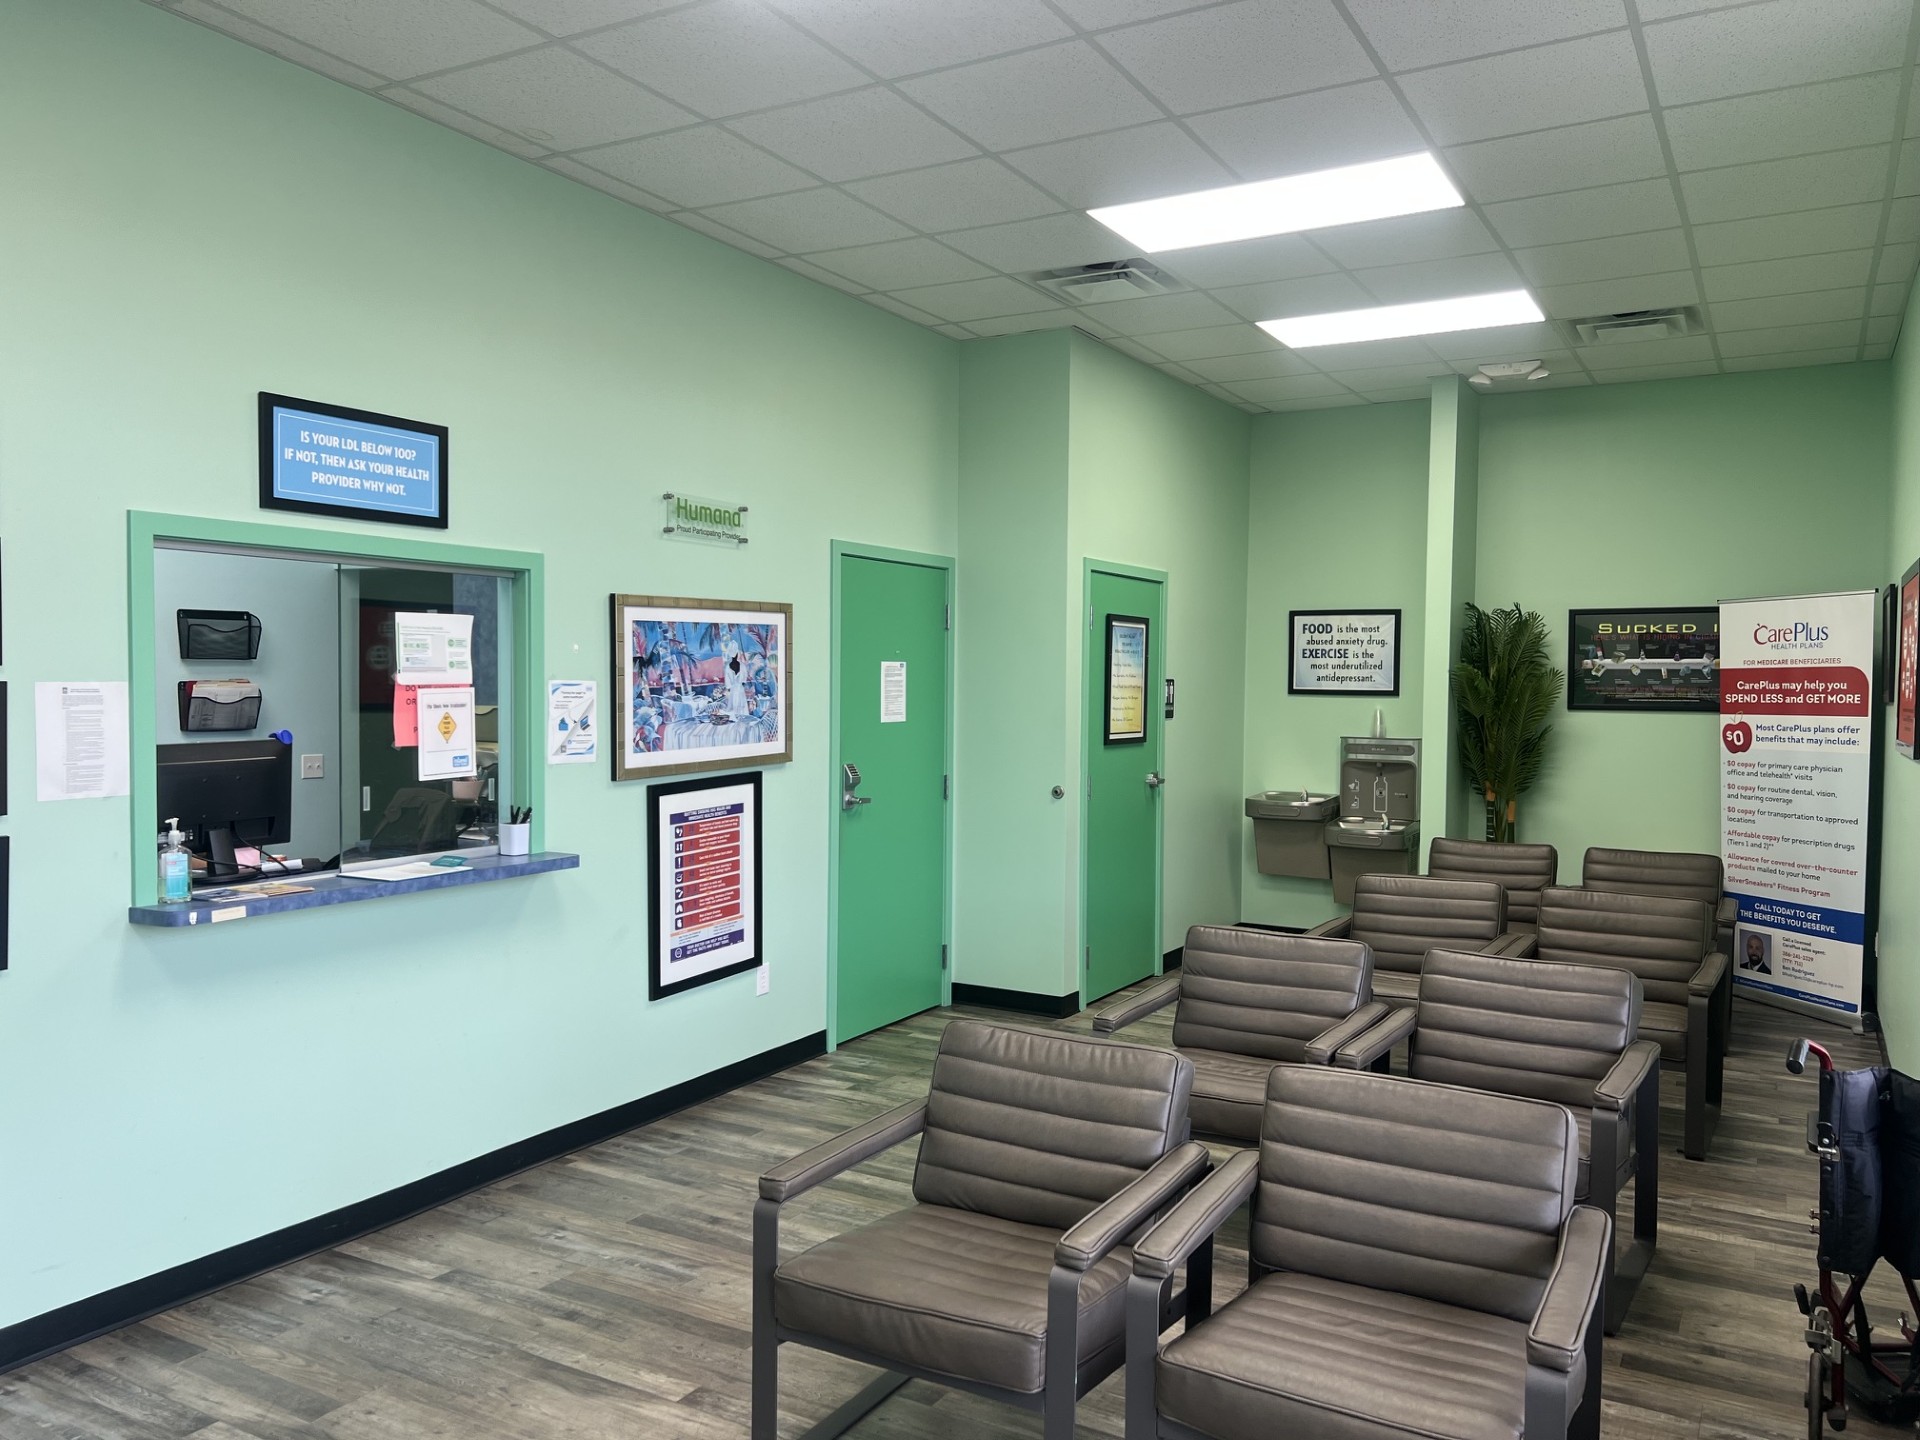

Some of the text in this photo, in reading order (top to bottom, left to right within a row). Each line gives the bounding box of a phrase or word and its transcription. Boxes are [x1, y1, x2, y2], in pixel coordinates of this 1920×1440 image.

[301, 430, 417, 461] IS YOUR LDL BELOW 100?
[284, 447, 430, 481] IF NOT, THEN ASK YOUR HEALTH
[312, 472, 406, 496] PROVIDER WHY NOT.
[676, 497, 741, 528] Humana
[677, 524, 691, 533] Proud
[692, 526, 721, 539] Participating
[1302, 623, 1380, 634] FOOD is the most
[1598, 623, 1697, 634] SUCKED
[1753, 622, 1829, 645] CarePlus
[1306, 635, 1388, 648] abused anxiety drug.
[1302, 648, 1374, 659] EXERCISE is the
[1310, 660, 1383, 670] most underutilized
[1316, 672, 1376, 684] antidepressant.
[1736, 681, 1847, 692] CarePlus may help you
[1725, 694, 1758, 704] SPEND
[1760, 694, 1784, 704] LESS
[1785, 694, 1804, 704] and
[1805, 694, 1826, 704] GET
[1827, 694, 1861, 704] MORE
[1755, 724, 1861, 735] Most CarePlus plans offer
[1726, 730, 1744, 746] $0
[1755, 734, 1860, 747] benefits that may include:
[1727, 760, 1736, 768] $0
[1757, 761, 1767, 769] for
[1768, 762, 1792, 771] primary
[1810, 765, 1843, 773] physician
[1727, 769, 1745, 777] office
[1727, 783, 1736, 791] $0
[1737, 785, 1756, 793] copay
[1767, 786, 1790, 794] routine
[1791, 788, 1815, 797] dental,
[1816, 790, 1838, 799] vision,
[1740, 794, 1764, 803] hearing
[1765, 796, 1793, 805] coverage
[1727, 806, 1859, 826] $0 copay for transportation to approved
[1727, 816, 1756, 825] locations
[1727, 830, 1855, 852] Affordable copay for prescription drugs
[1727, 838, 1745, 847] (Tiers
[1750, 841, 1762, 849] and
[1727, 853, 1759, 863] Allowance
[1770, 858, 1795, 868] covered
[1796, 862, 1858, 876] over-the-counter
[1727, 863, 1821, 881] products mailed to your home
[1777, 884, 1800, 893] Fitness
[1801, 887, 1830, 898] Program
[1755, 902, 1821, 921] CALL TODAY TO GET
[1740, 909, 1837, 934] THE BENEFITS YOU DESERVE.
